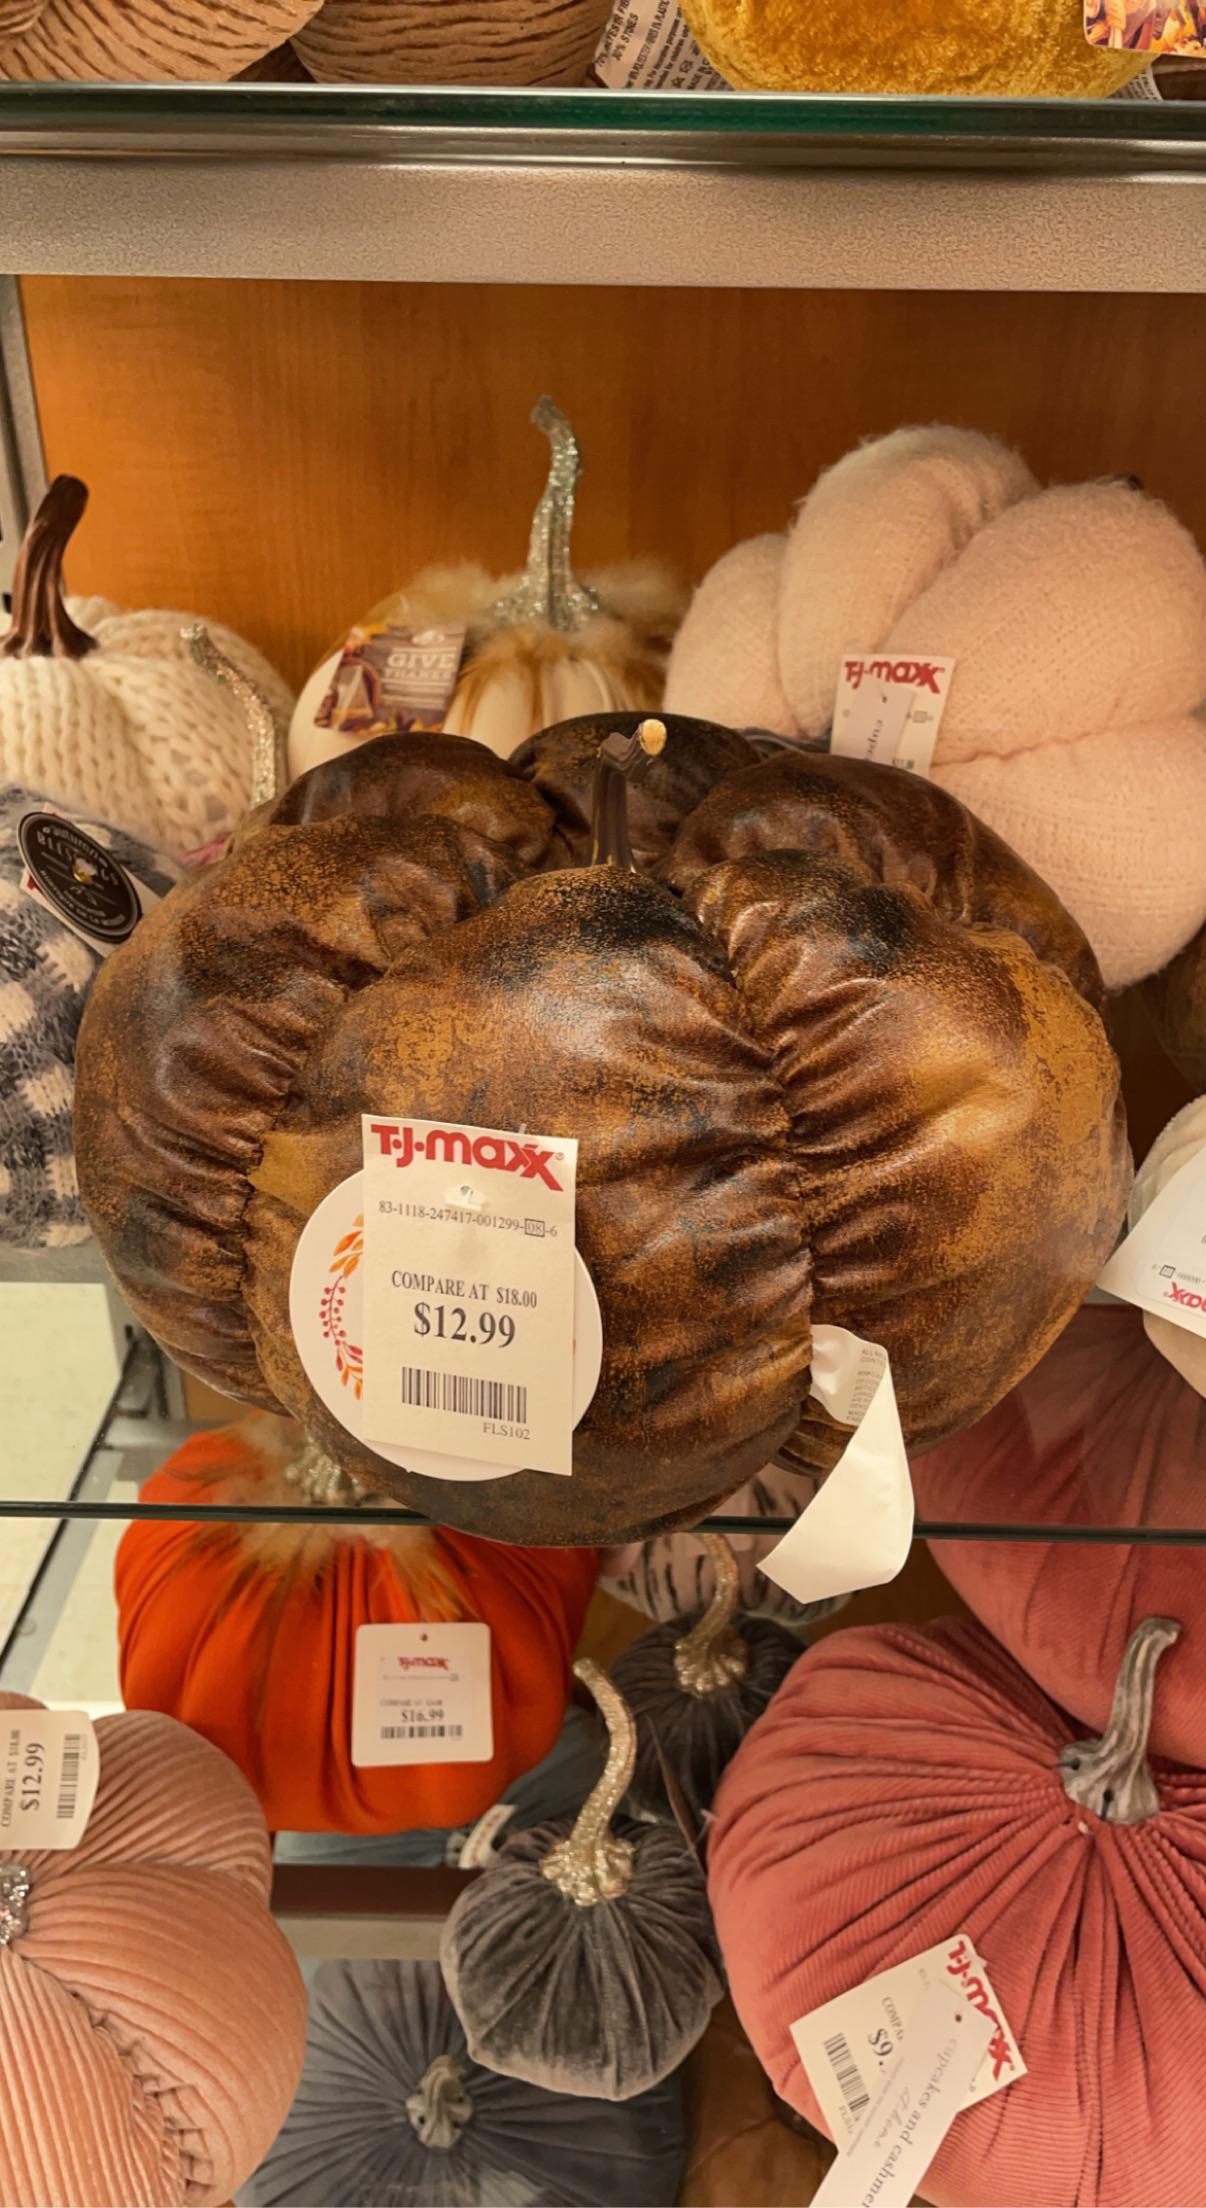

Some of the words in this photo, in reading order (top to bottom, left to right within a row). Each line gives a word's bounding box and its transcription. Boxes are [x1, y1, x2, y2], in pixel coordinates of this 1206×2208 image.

[387, 651, 456, 669] GIVE
[391, 1269, 465, 1298] COMPARE
[468, 1283, 489, 1301] AT
[496, 1285, 537, 1309] $18.00
[413, 1302, 515, 1349] $12.99
[483, 1421, 531, 1440] FLS102
[400, 1709, 445, 1723] $16.99
[7, 1762, 17, 1774] AT
[20, 1742, 46, 1811] $12.99
[1, 1778, 16, 1828] COMPARE
[881, 1996, 905, 2041] COMPA
[918, 2037, 958, 2109] cupcakes
[899, 2107, 925, 2146] and
